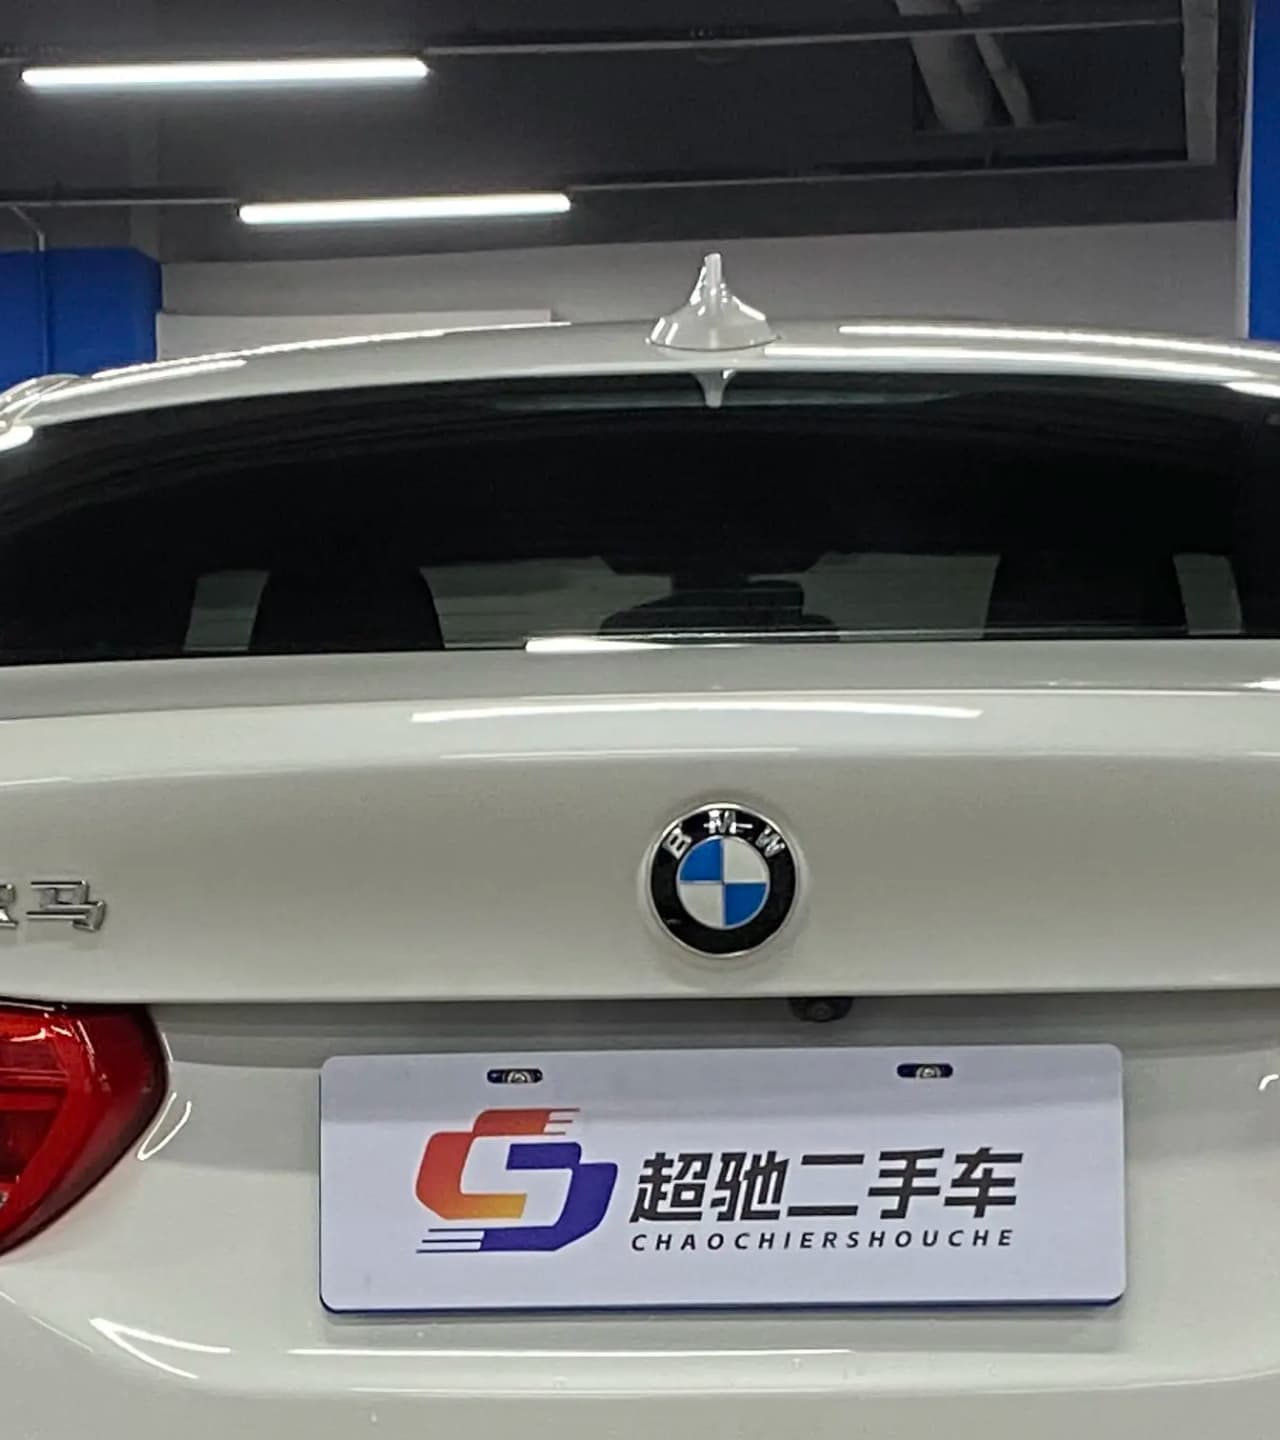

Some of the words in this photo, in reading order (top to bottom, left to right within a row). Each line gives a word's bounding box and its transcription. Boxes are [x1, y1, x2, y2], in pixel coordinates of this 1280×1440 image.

[629, 1146, 1024, 1224] 超驰二手车
[630, 1229, 1014, 1252] CHAOCHIERSHOUCHE
